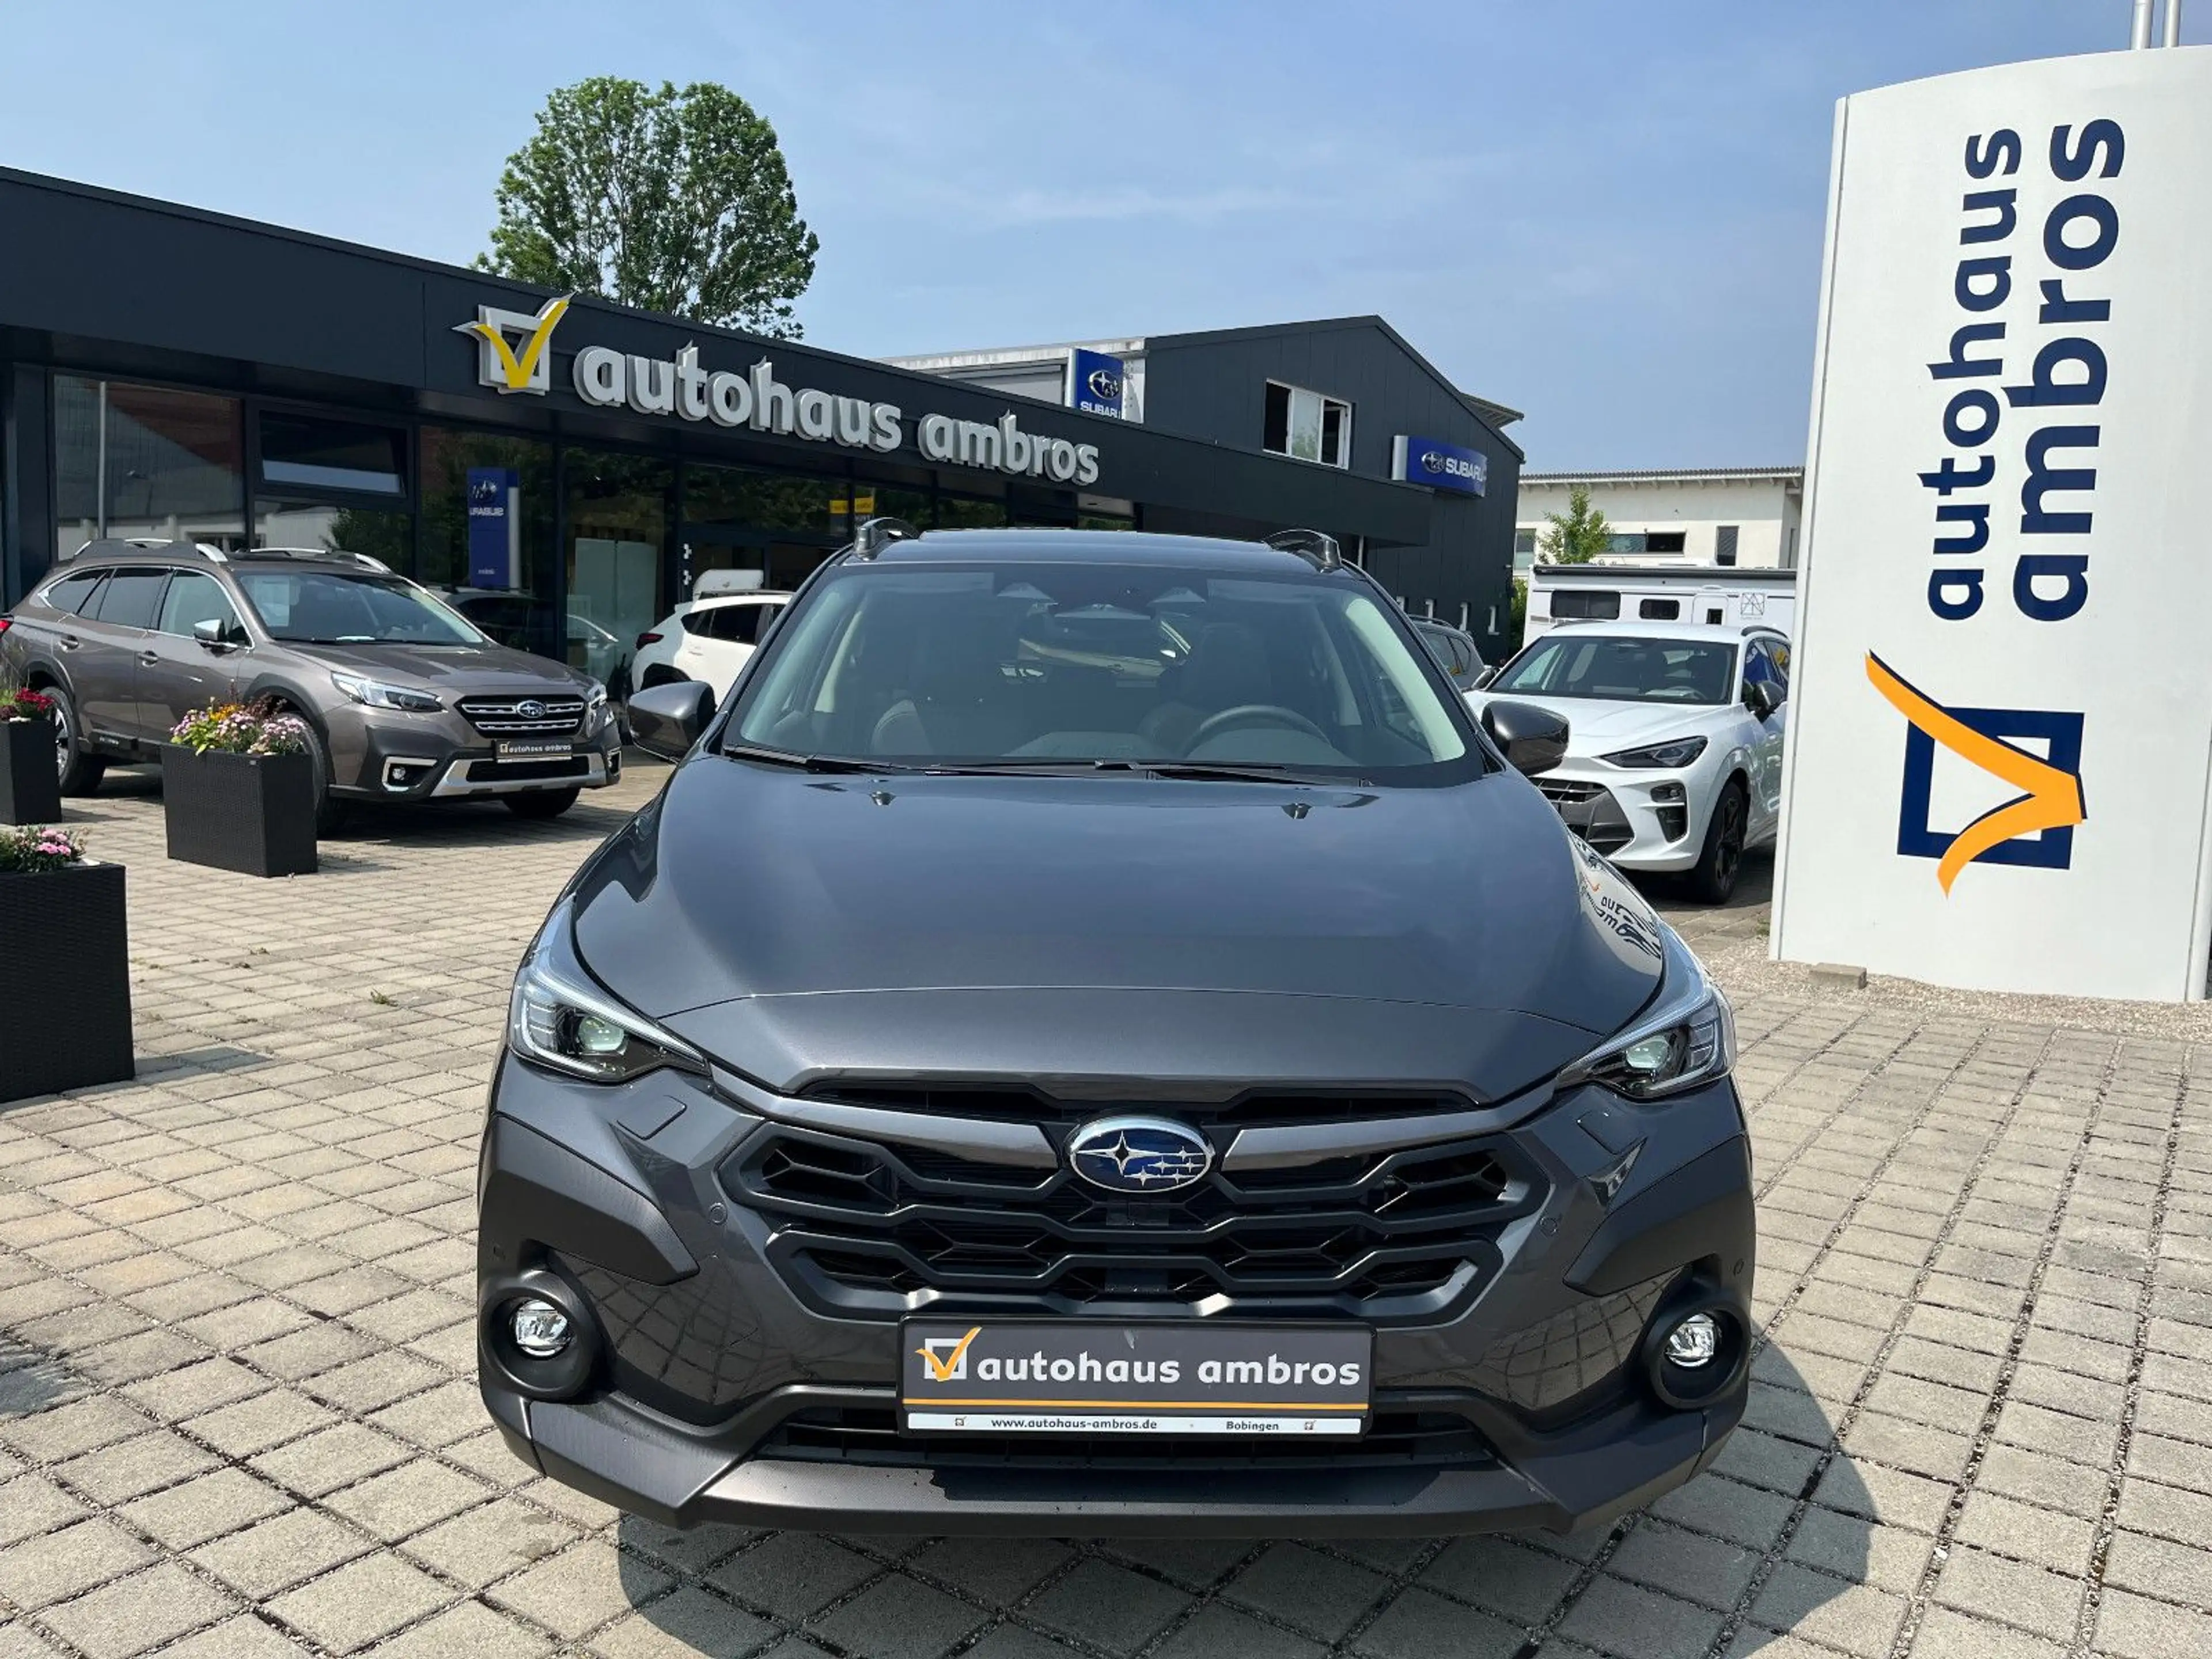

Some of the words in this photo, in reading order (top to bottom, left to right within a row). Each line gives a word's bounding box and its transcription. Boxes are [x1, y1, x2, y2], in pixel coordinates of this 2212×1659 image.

[573, 340, 902, 453] autohaus
[918, 410, 1099, 486] ambros
[1917, 128, 2022, 621] autohaus
[2001, 118, 2125, 622] ambros
[977, 1350, 1181, 1382] autohaus
[1198, 1353, 1361, 1385] ambros
[991, 1418, 1158, 1429] www.autohaus-ambros.de
[1225, 1421, 1279, 1431] Bobingen
